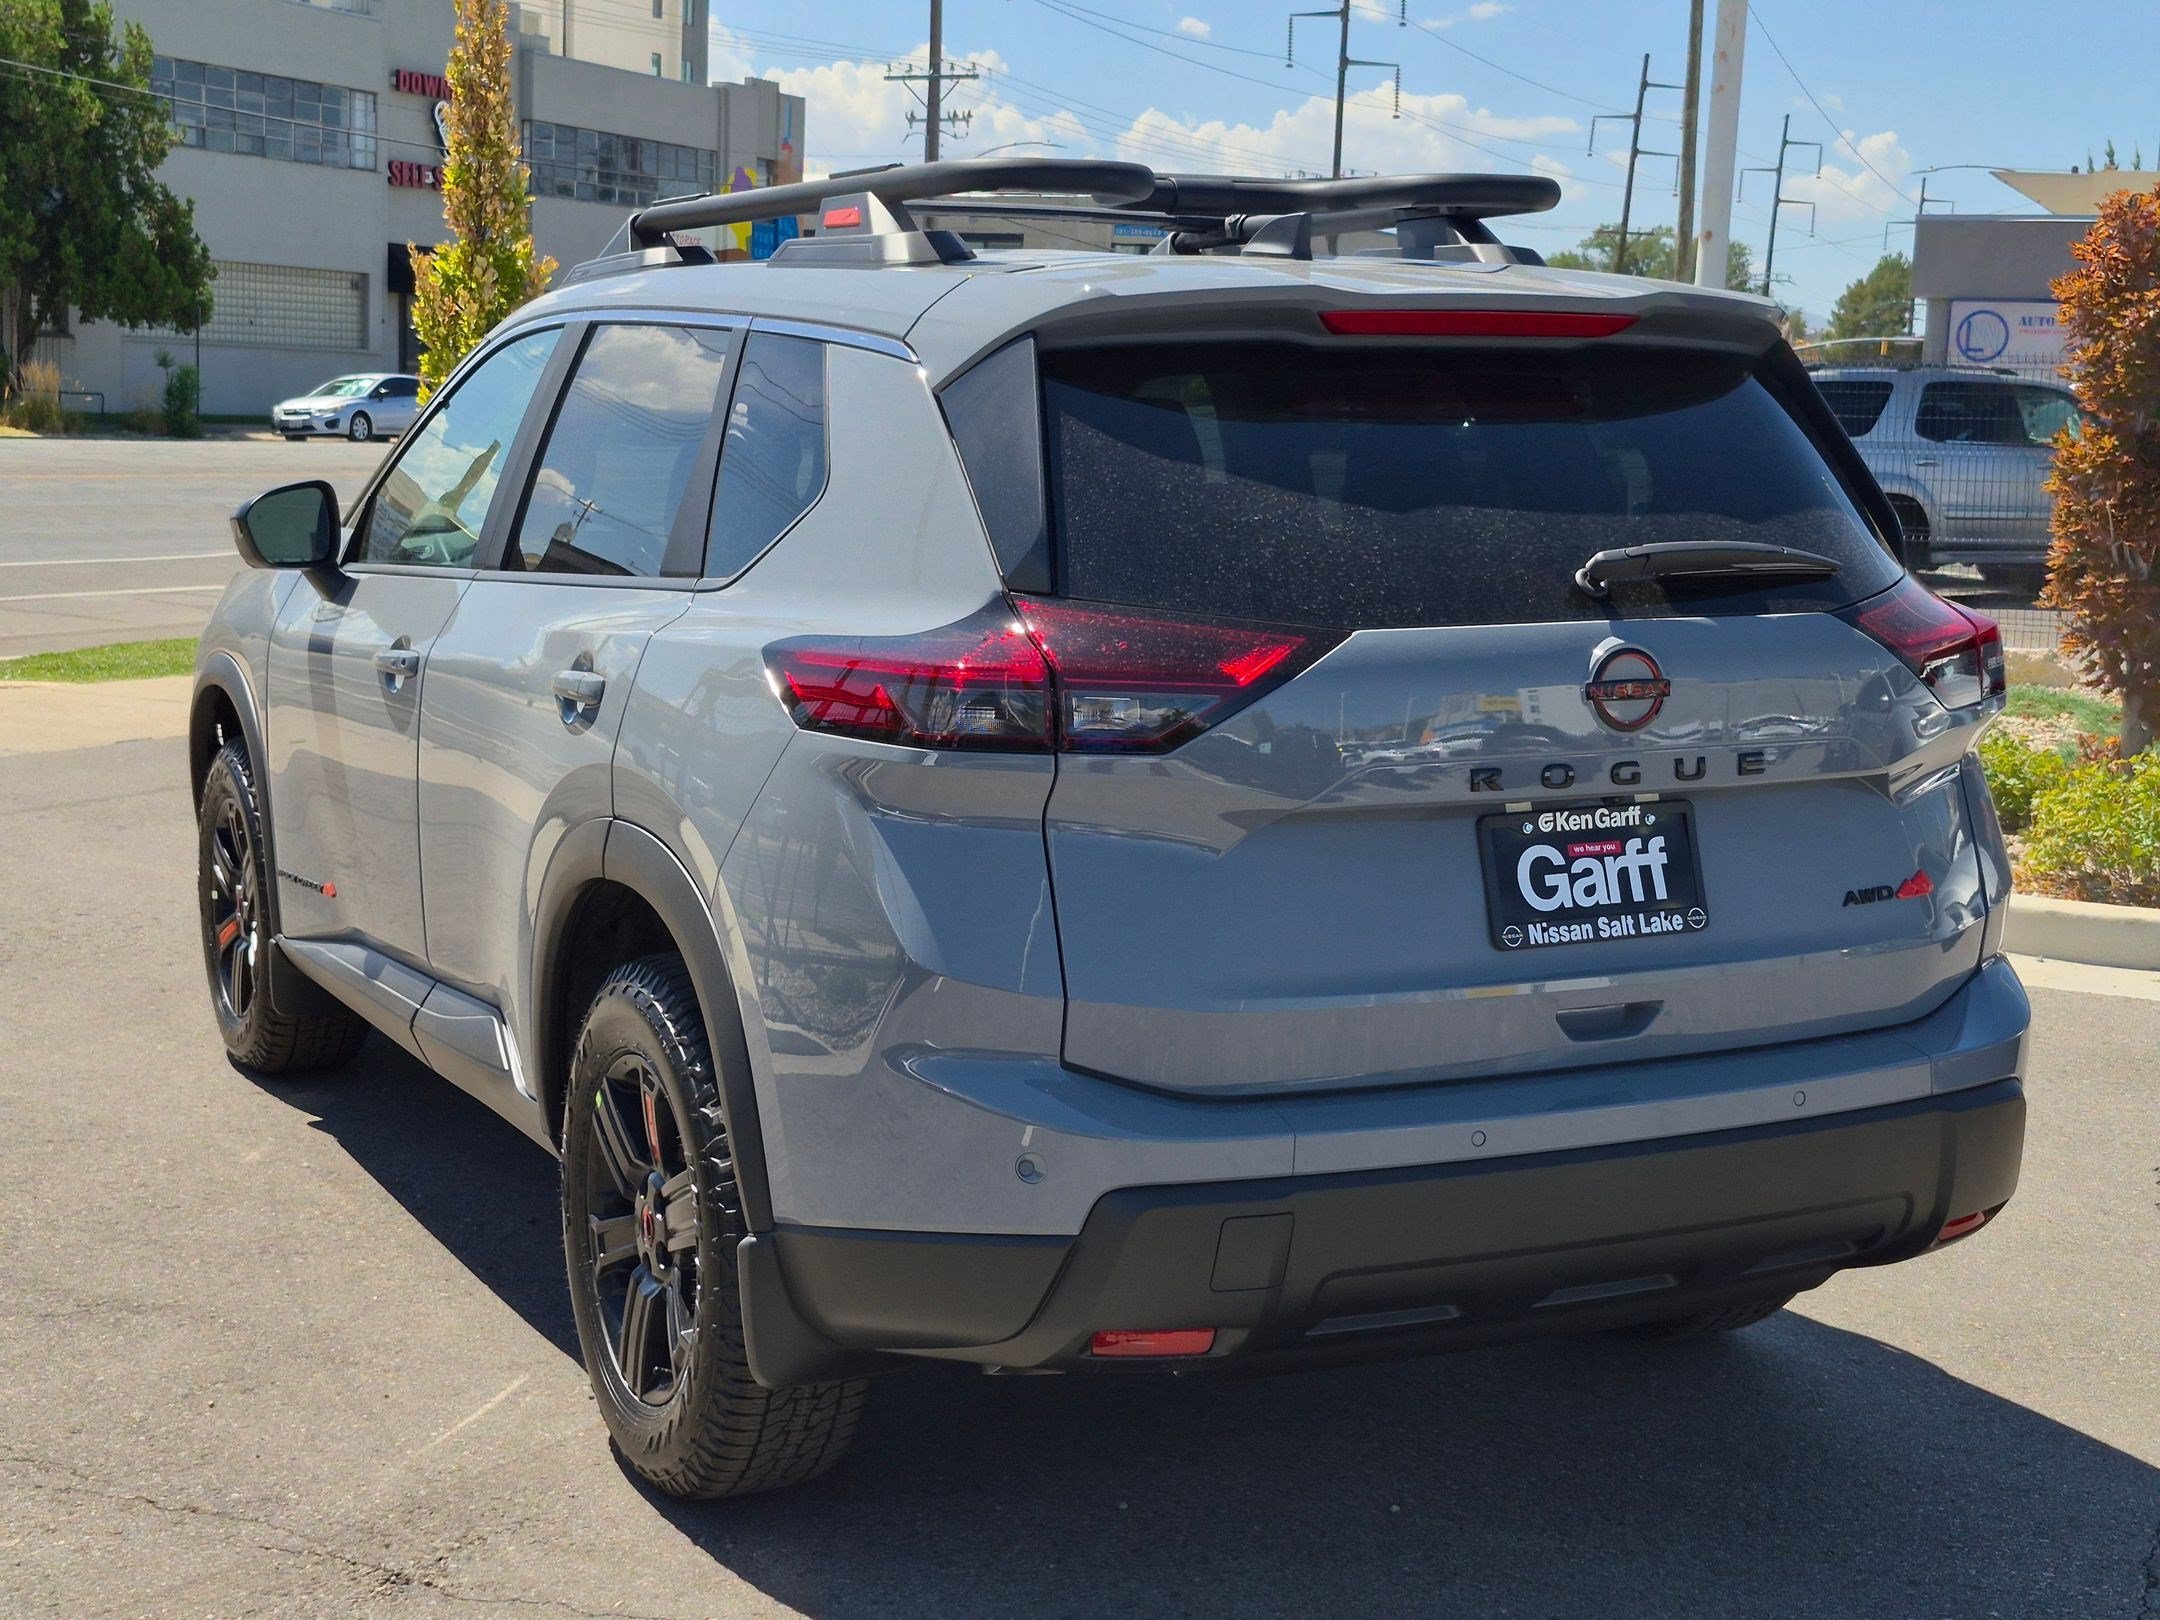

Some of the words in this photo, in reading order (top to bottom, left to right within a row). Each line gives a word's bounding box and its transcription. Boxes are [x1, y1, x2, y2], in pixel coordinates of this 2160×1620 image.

[2019, 316, 2055, 327] AUTO
[1590, 682, 1670, 697] NISSAN
[1470, 751, 1766, 792] ROGUE
[1586, 844, 1601, 852] hear
[1602, 843, 1616, 853] you
[1517, 836, 1668, 912] Garff
[1842, 885, 1894, 907] AWD
[1528, 922, 1594, 945] Nissan
[1597, 915, 1636, 938] Salt
[1638, 911, 1684, 934] Lake
